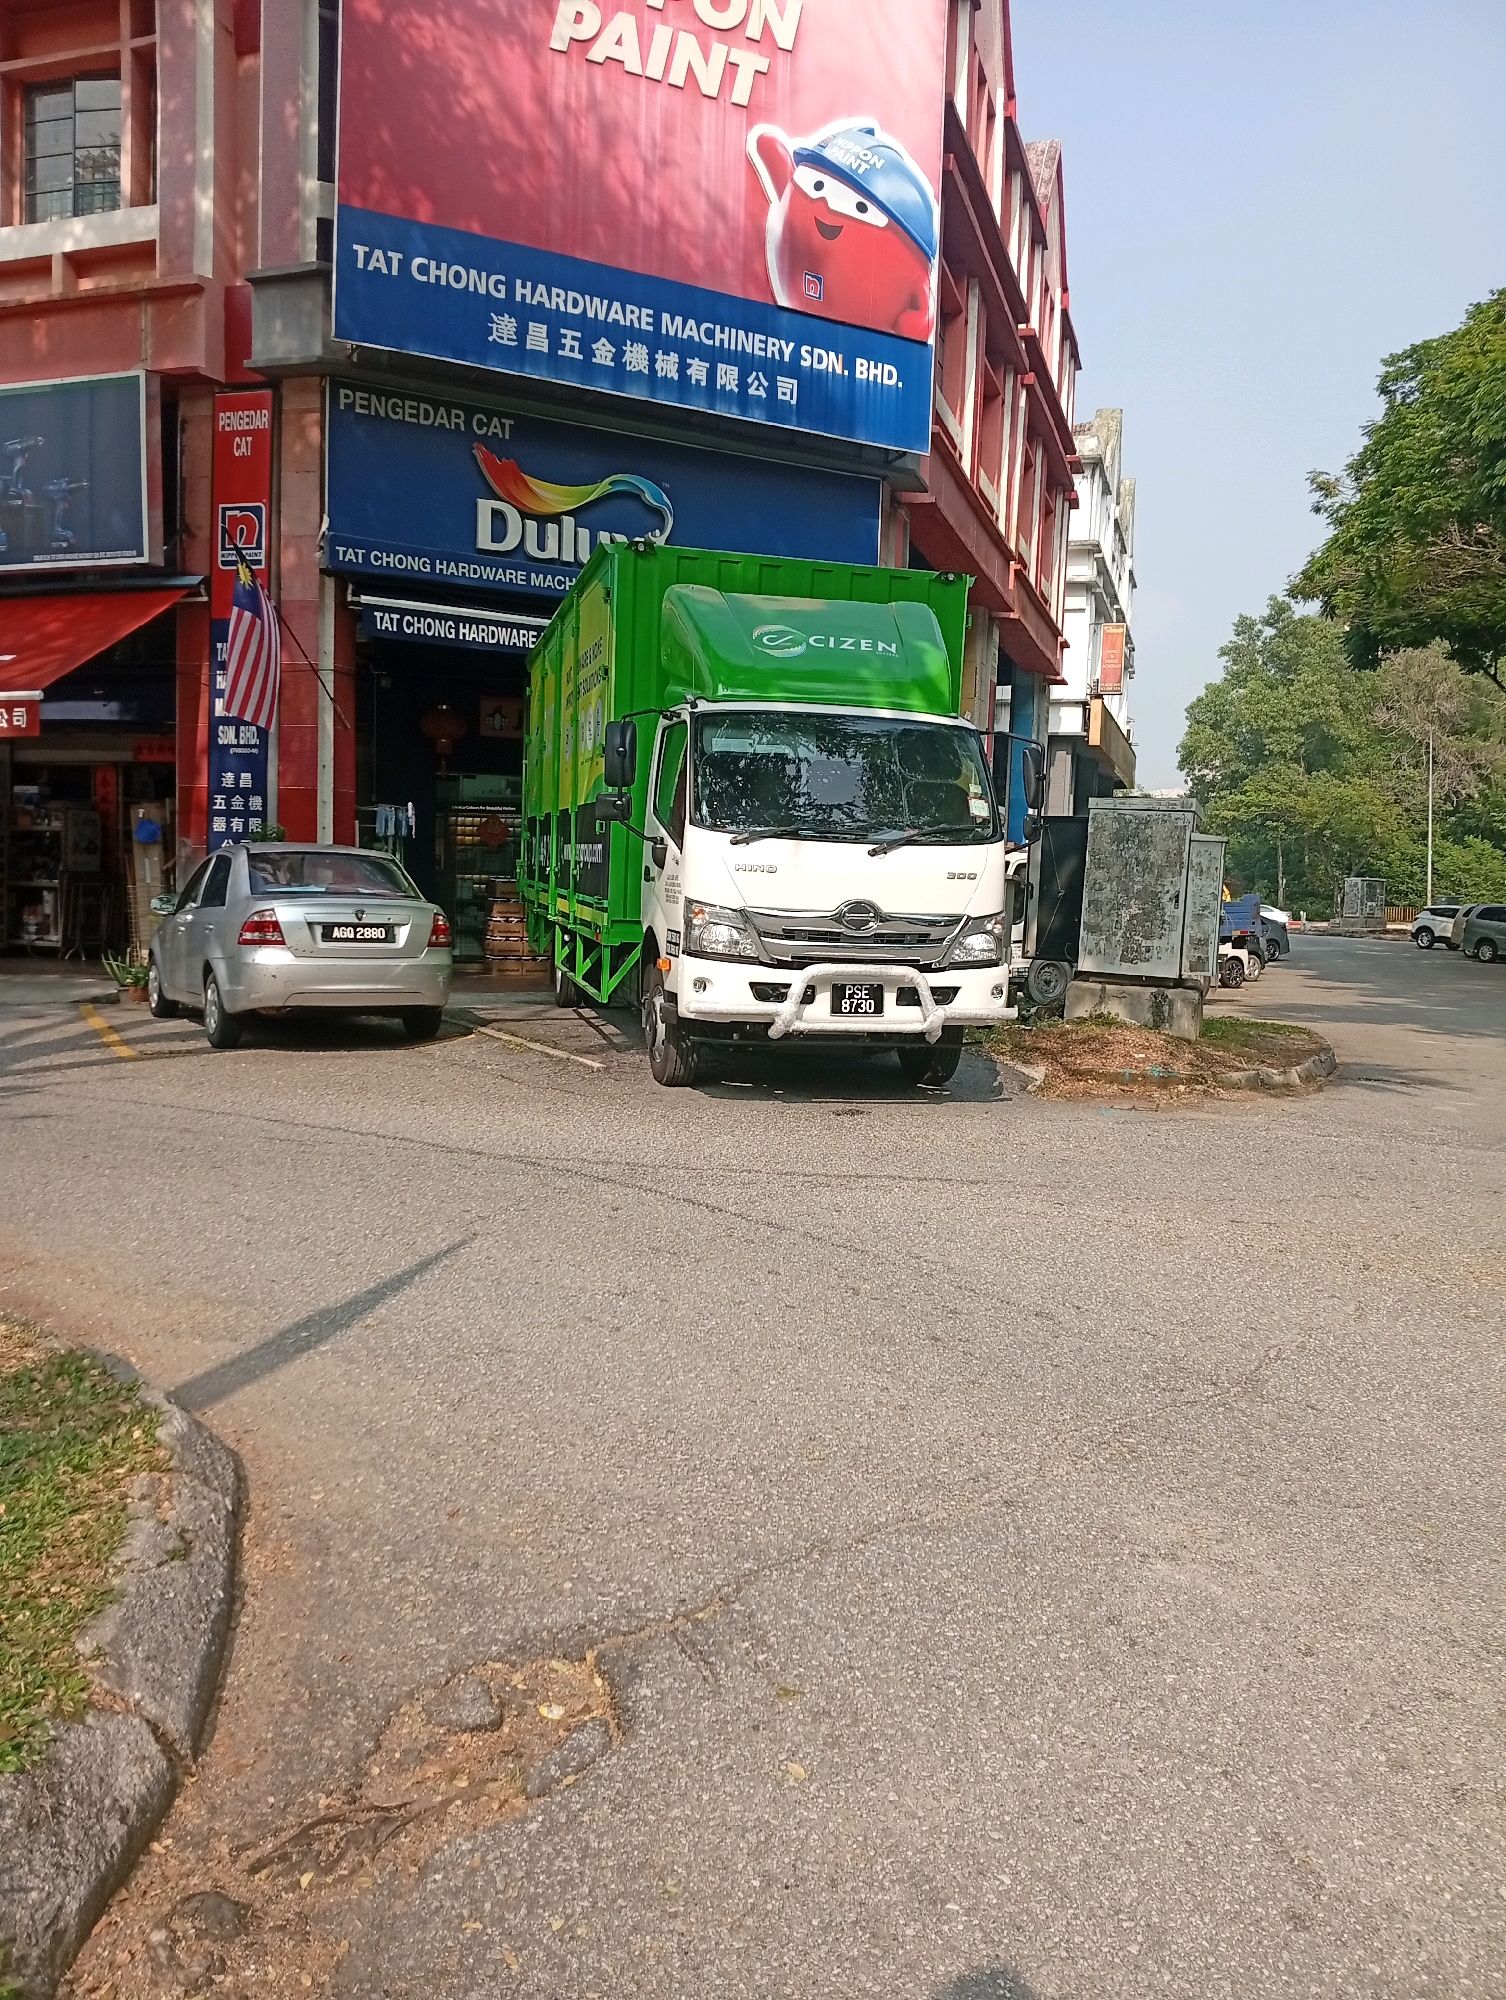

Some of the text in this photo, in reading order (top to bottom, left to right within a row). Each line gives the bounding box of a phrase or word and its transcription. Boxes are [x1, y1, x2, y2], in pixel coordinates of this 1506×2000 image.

[549, 0, 770, 108] PAINT
[829, 145, 871, 175] PAINT
[833, 137, 885, 170] NIPPON
[352, 244, 903, 388] TAT CHONG HARDWARE MACHINERY SDN. BHD.
[487, 312, 798, 405] 達昌五金機械有限公司
[218, 409, 269, 432] PENGEDAR
[339, 388, 515, 439] PENGEDAR CAT
[233, 436, 253, 457] CAT
[476, 498, 645, 566] Dulu
[335, 546, 366, 564] TAT
[370, 550, 431, 573] CHONG
[435, 560, 527, 586] HARDWARE
[373, 611, 538, 650] TAT CHONG HARDWARE
[808, 635, 897, 653] CIZEN
[218, 726, 259, 745] SDN. BHD.
[221, 772, 253, 788] 達昌
[212, 795, 263, 811] 五金機
[212, 817, 262, 833] 器有限
[734, 863, 778, 874] HINO
[946, 872, 978, 880] 300
[332, 927, 386, 939] AGQ 2880
[845, 985, 870, 999] PSE
[841, 999, 875, 1013] 8730
